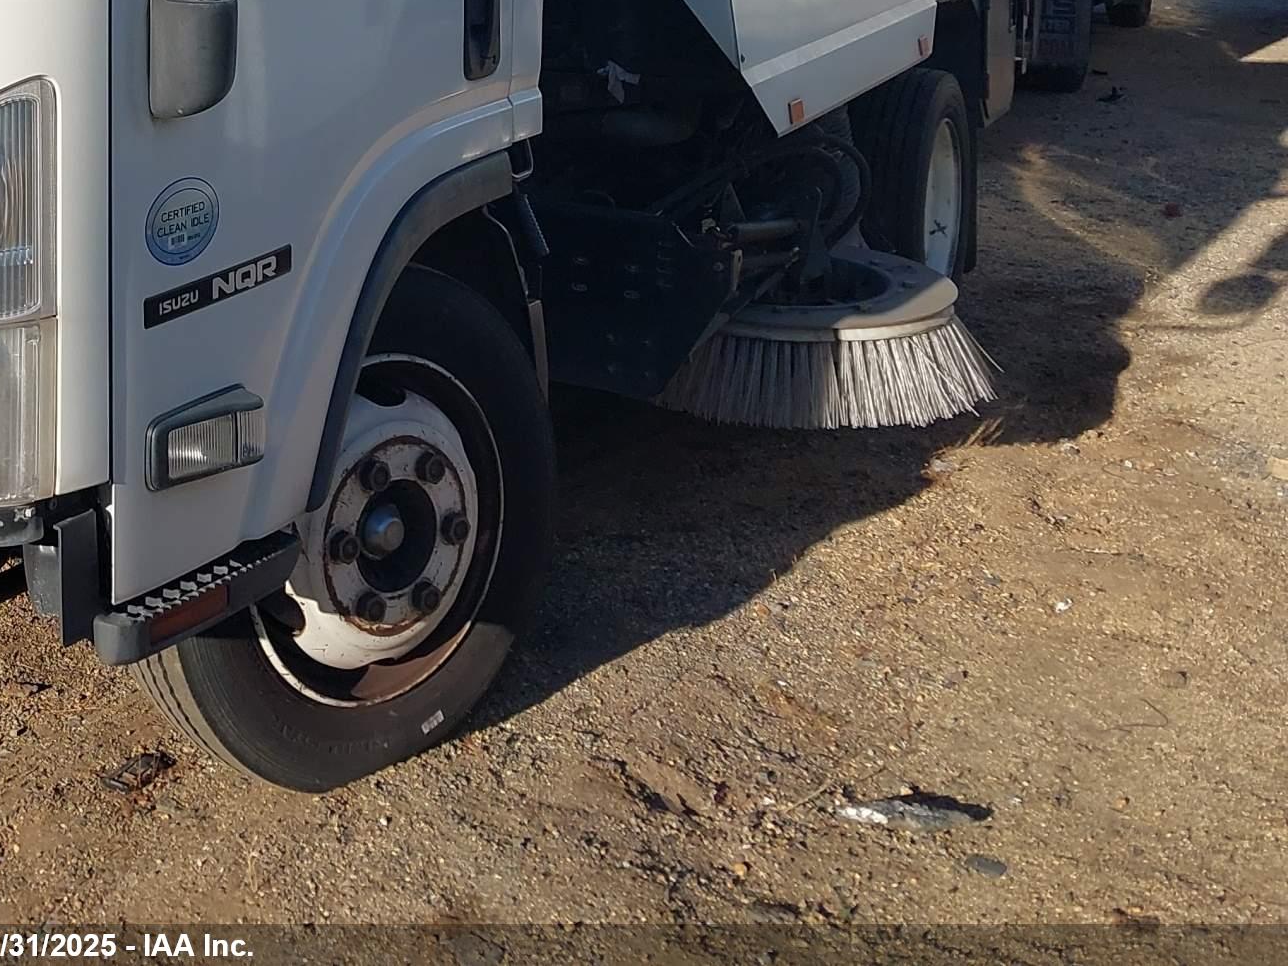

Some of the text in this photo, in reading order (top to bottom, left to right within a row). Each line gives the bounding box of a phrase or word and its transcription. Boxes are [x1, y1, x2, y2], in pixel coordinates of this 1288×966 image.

[161, 201, 206, 223] CERTIFIED
[157, 221, 187, 238] CLEAN
[191, 214, 210, 227] IDLE
[159, 255, 277, 316] ISUZU NQR
